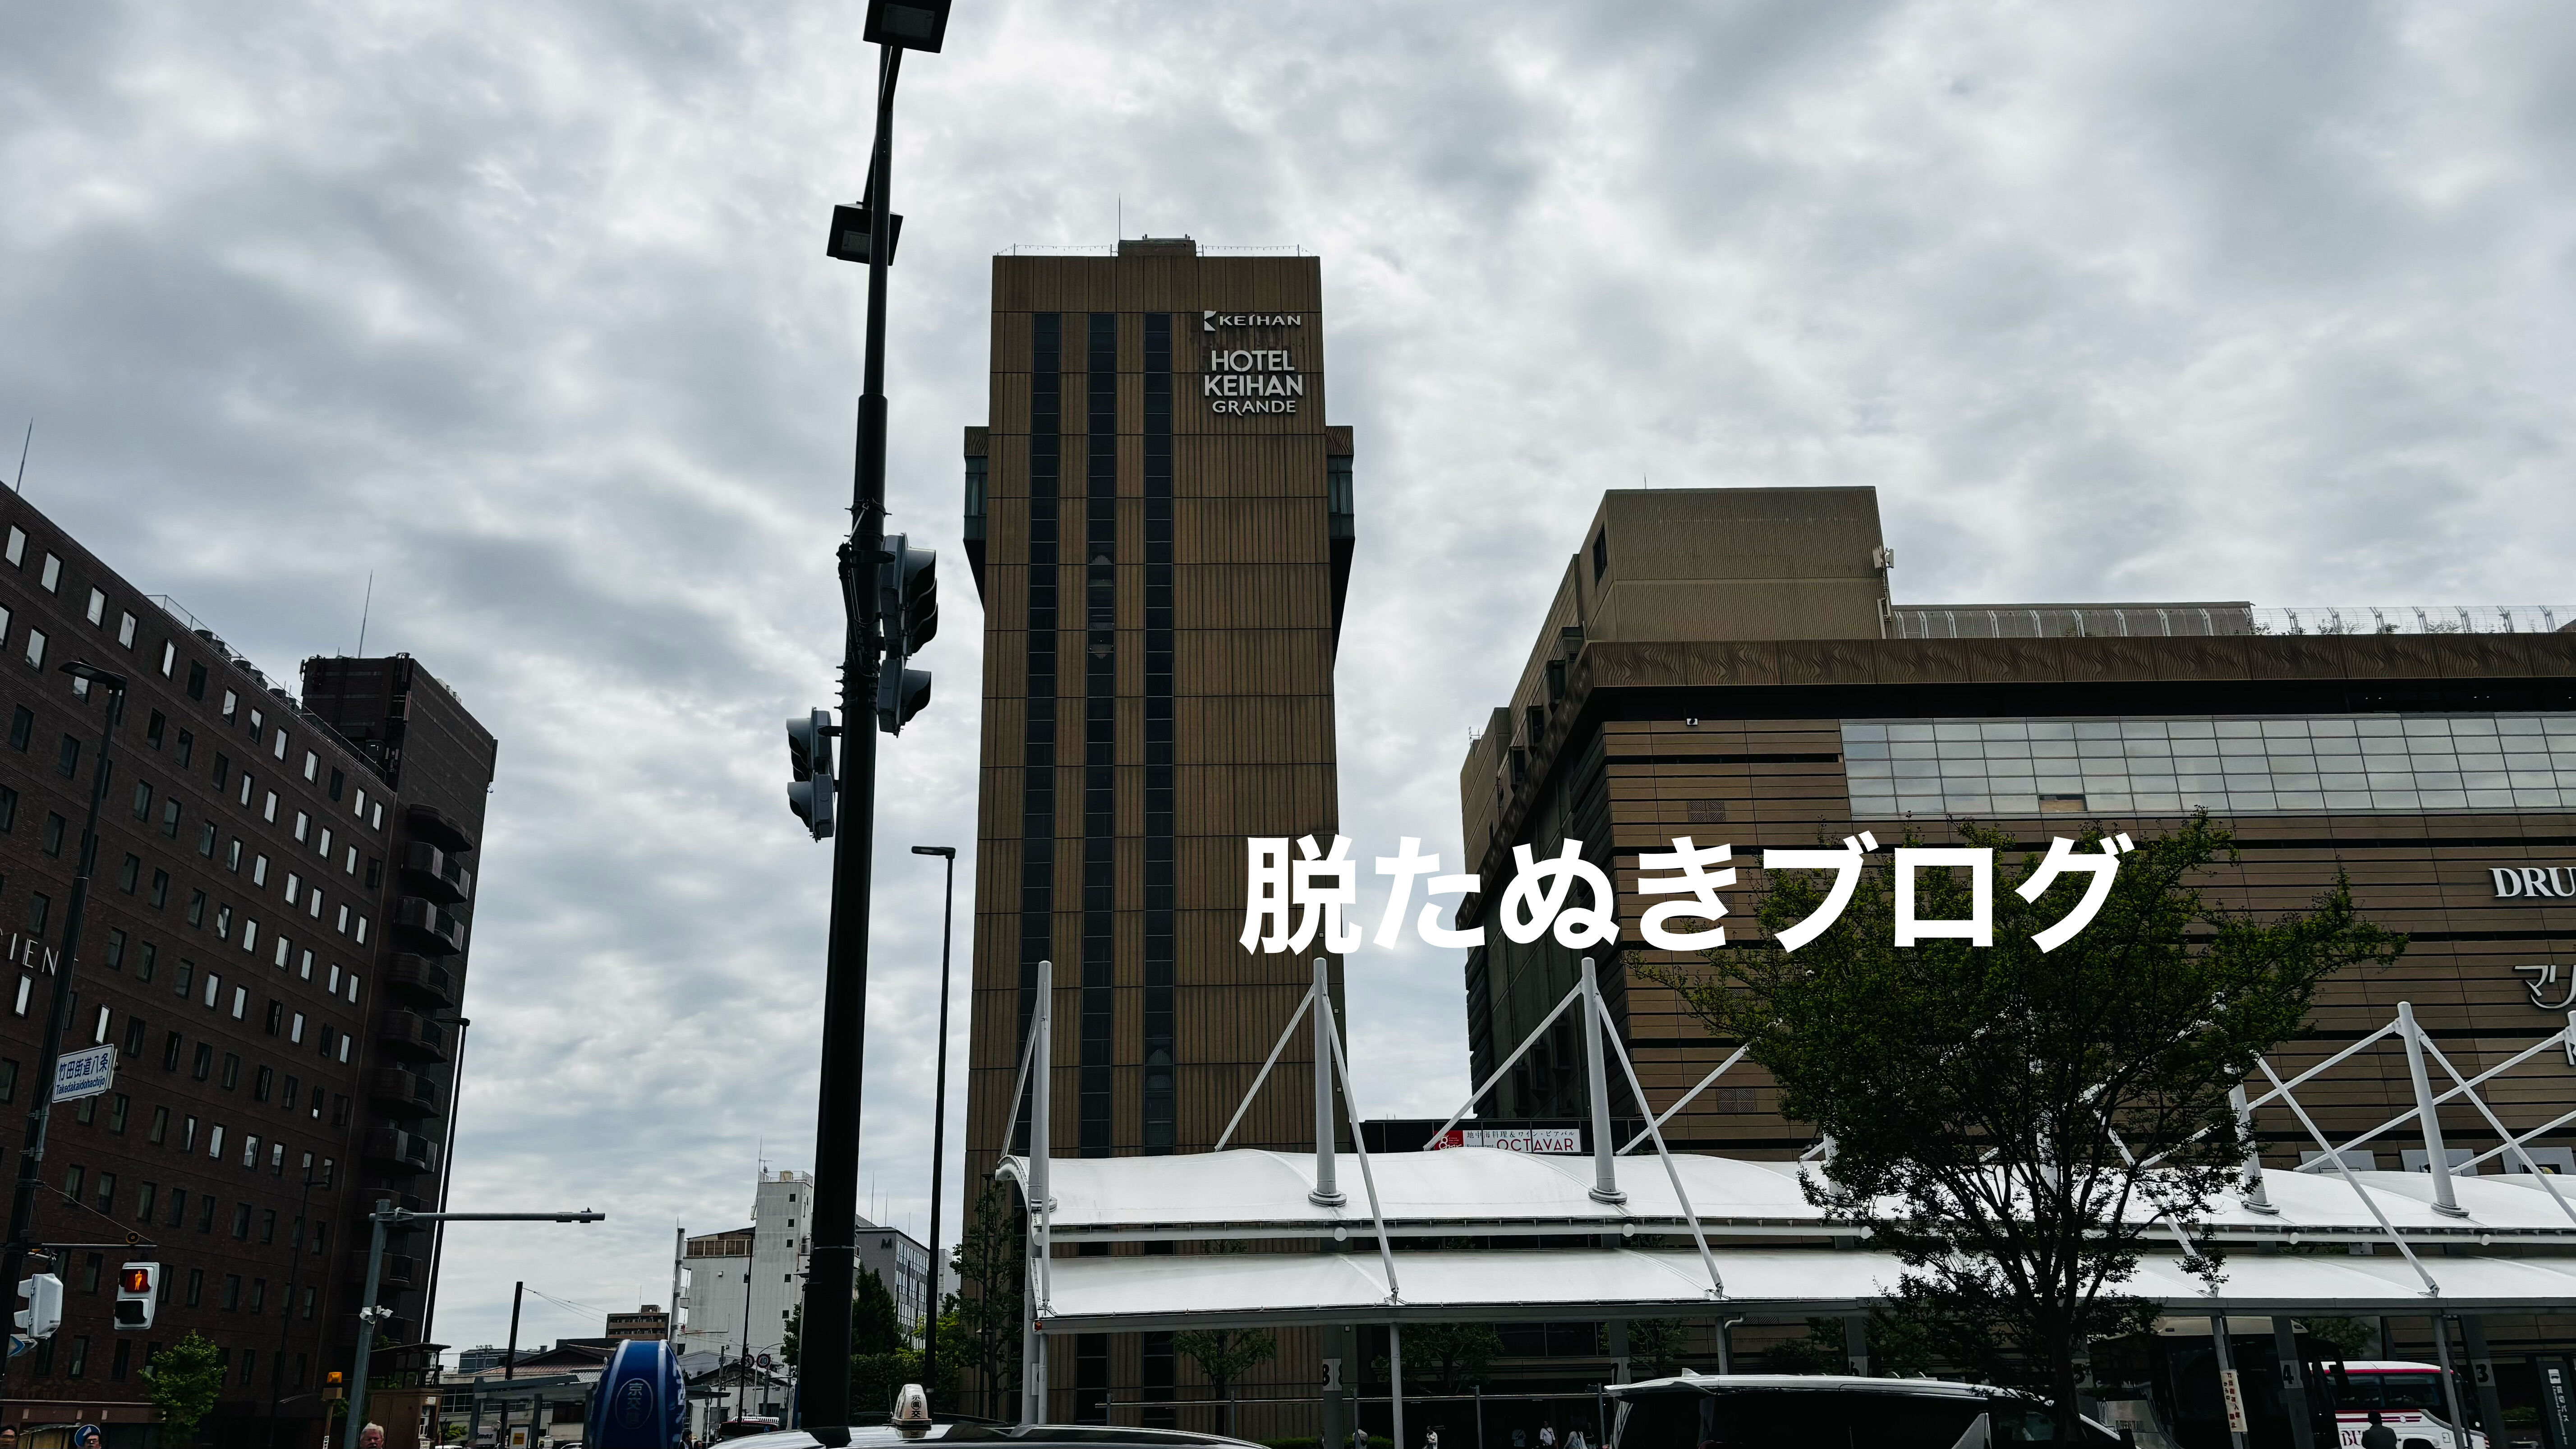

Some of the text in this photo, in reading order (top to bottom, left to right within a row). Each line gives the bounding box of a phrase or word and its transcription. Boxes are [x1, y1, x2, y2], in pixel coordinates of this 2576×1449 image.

[1219, 314, 1301, 326] KEIHAN
[1211, 350, 1295, 372] HOTEL
[1205, 375, 1303, 396] KEIHAN
[1212, 400, 1296, 416] GRANDE
[2489, 867, 2576, 897] DRU
[59, 1053, 108, 1081] 竹田街道八条
[1497, 1139, 1573, 1151] OCTAVAR
[2283, 1365, 2294, 1384] 4
[2476, 1364, 2488, 1382] 3
[2340, 1430, 2362, 1446] BU
